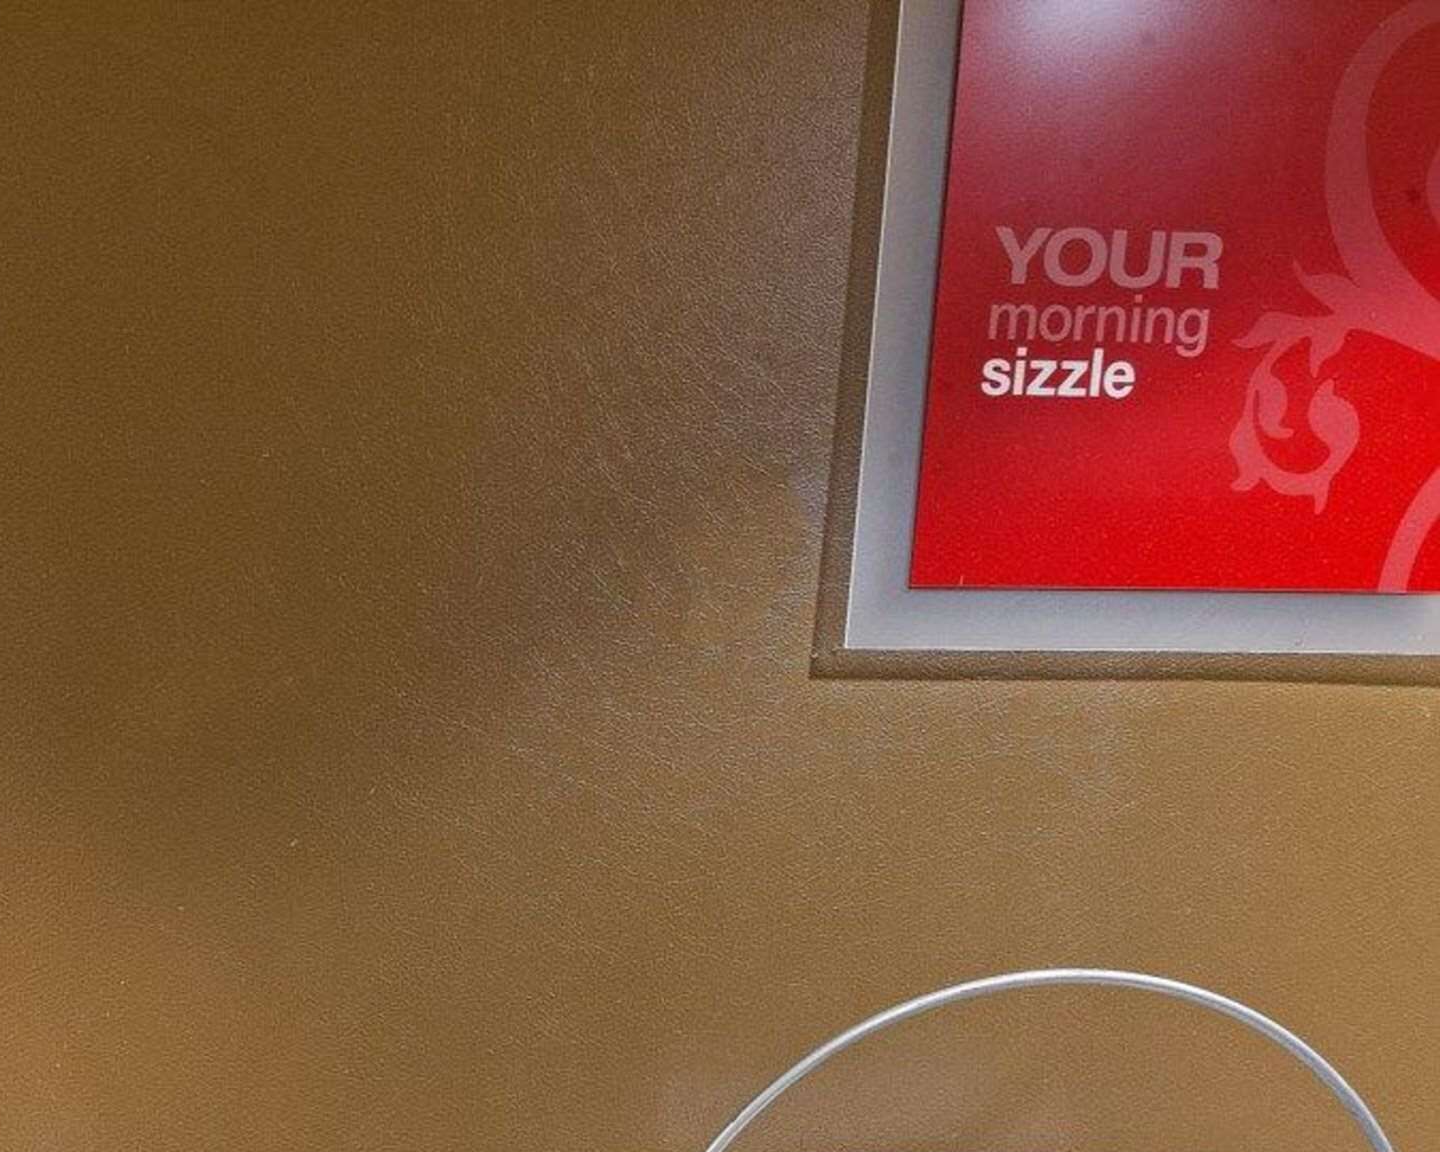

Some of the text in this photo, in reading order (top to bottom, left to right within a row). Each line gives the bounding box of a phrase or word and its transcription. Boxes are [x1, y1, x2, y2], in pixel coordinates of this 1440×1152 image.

[995, 226, 1224, 290] YOUR
[987, 294, 1211, 358] morning
[980, 347, 1136, 399] sizzle
